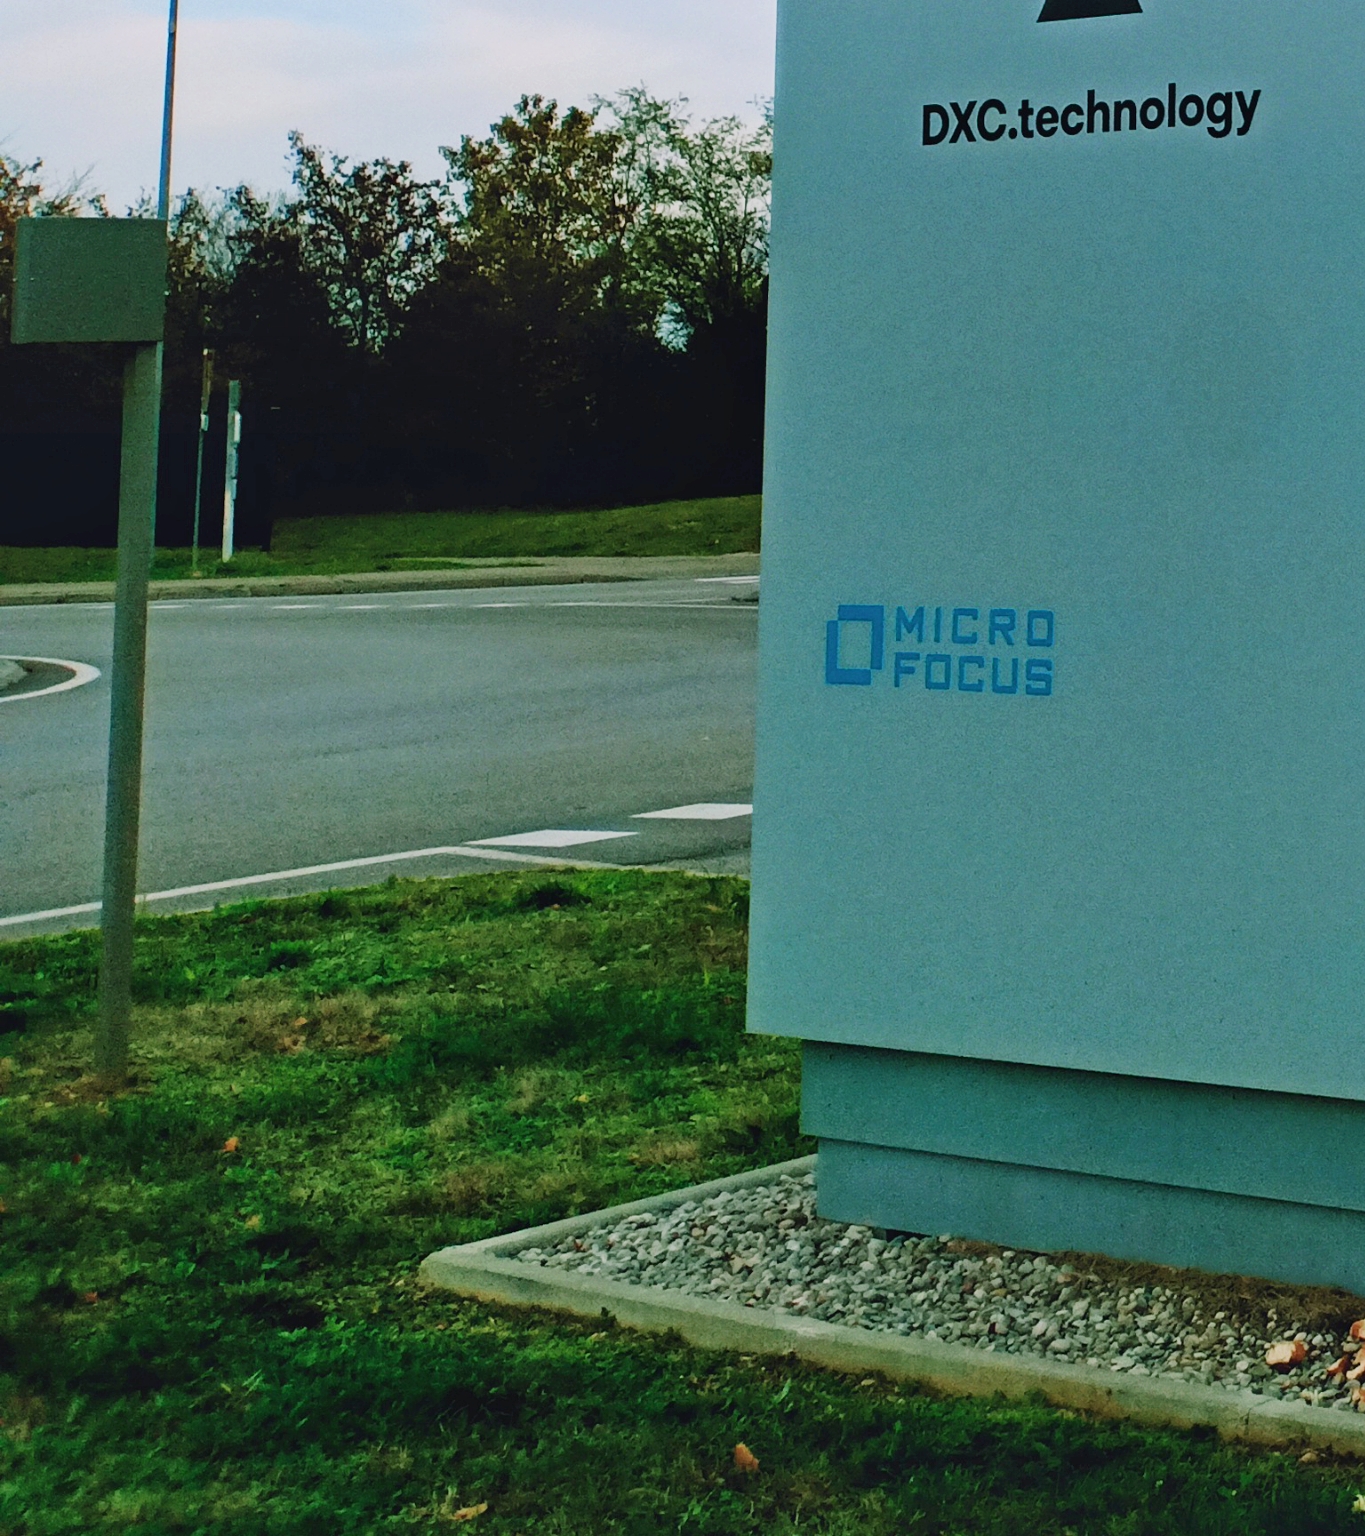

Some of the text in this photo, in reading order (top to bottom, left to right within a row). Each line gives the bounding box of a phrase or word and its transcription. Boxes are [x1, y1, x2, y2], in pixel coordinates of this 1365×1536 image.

[922, 82, 1262, 146] DXC.technology
[895, 605, 1055, 647] MICRO
[893, 651, 1053, 696] FOCUS
